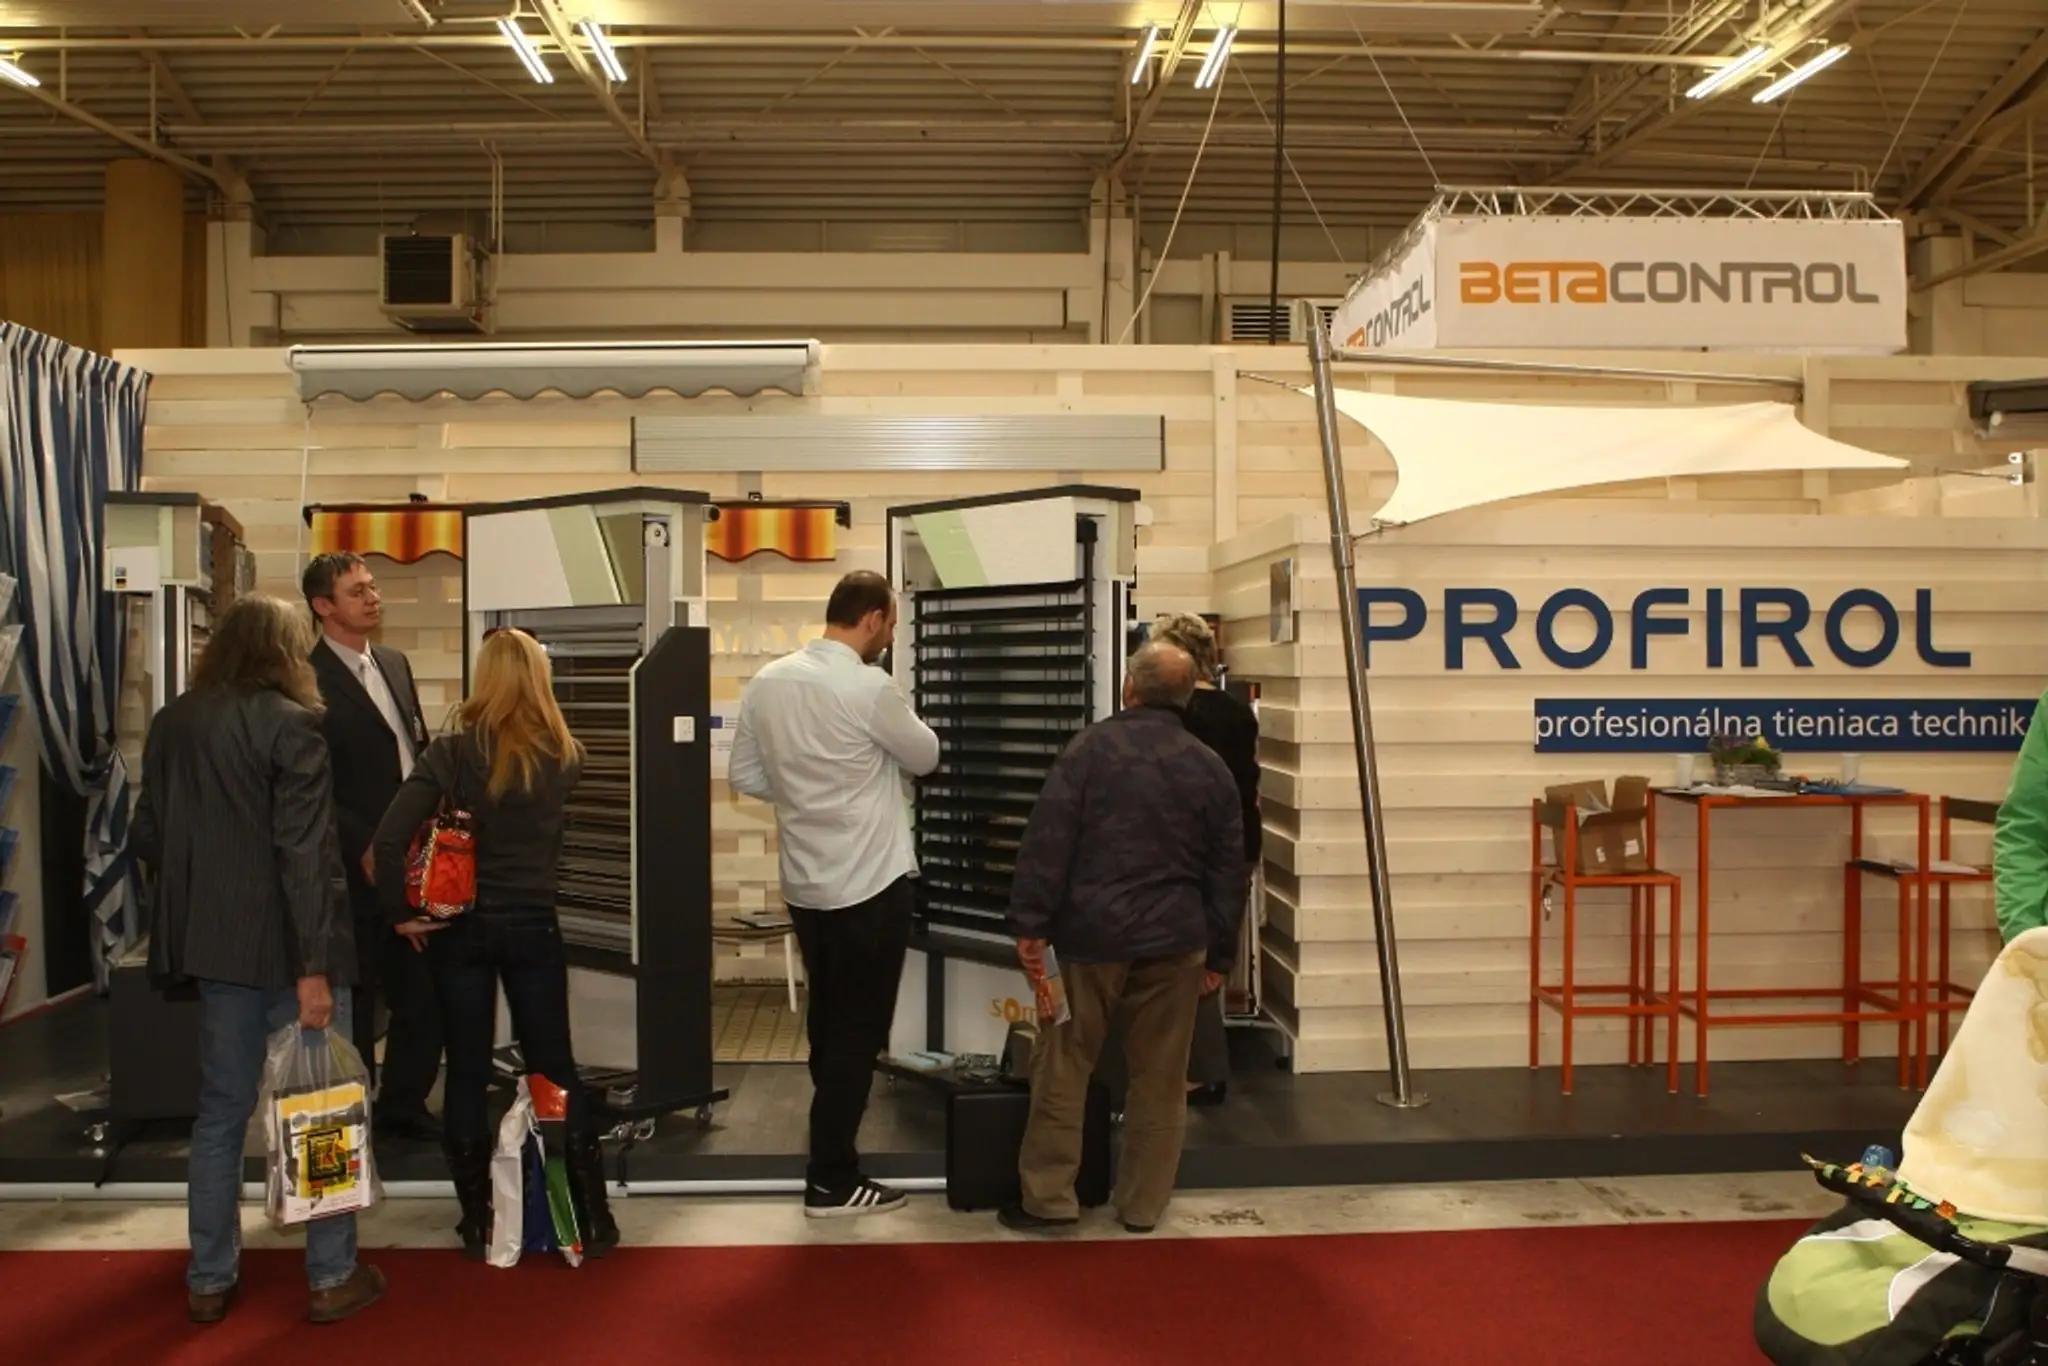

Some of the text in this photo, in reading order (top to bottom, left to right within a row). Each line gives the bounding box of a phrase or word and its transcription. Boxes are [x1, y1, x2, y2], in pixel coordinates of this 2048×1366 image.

[1356, 588, 1971, 668] PROFIROL
[1535, 706, 2027, 745] profesionálna tieniaca technik
